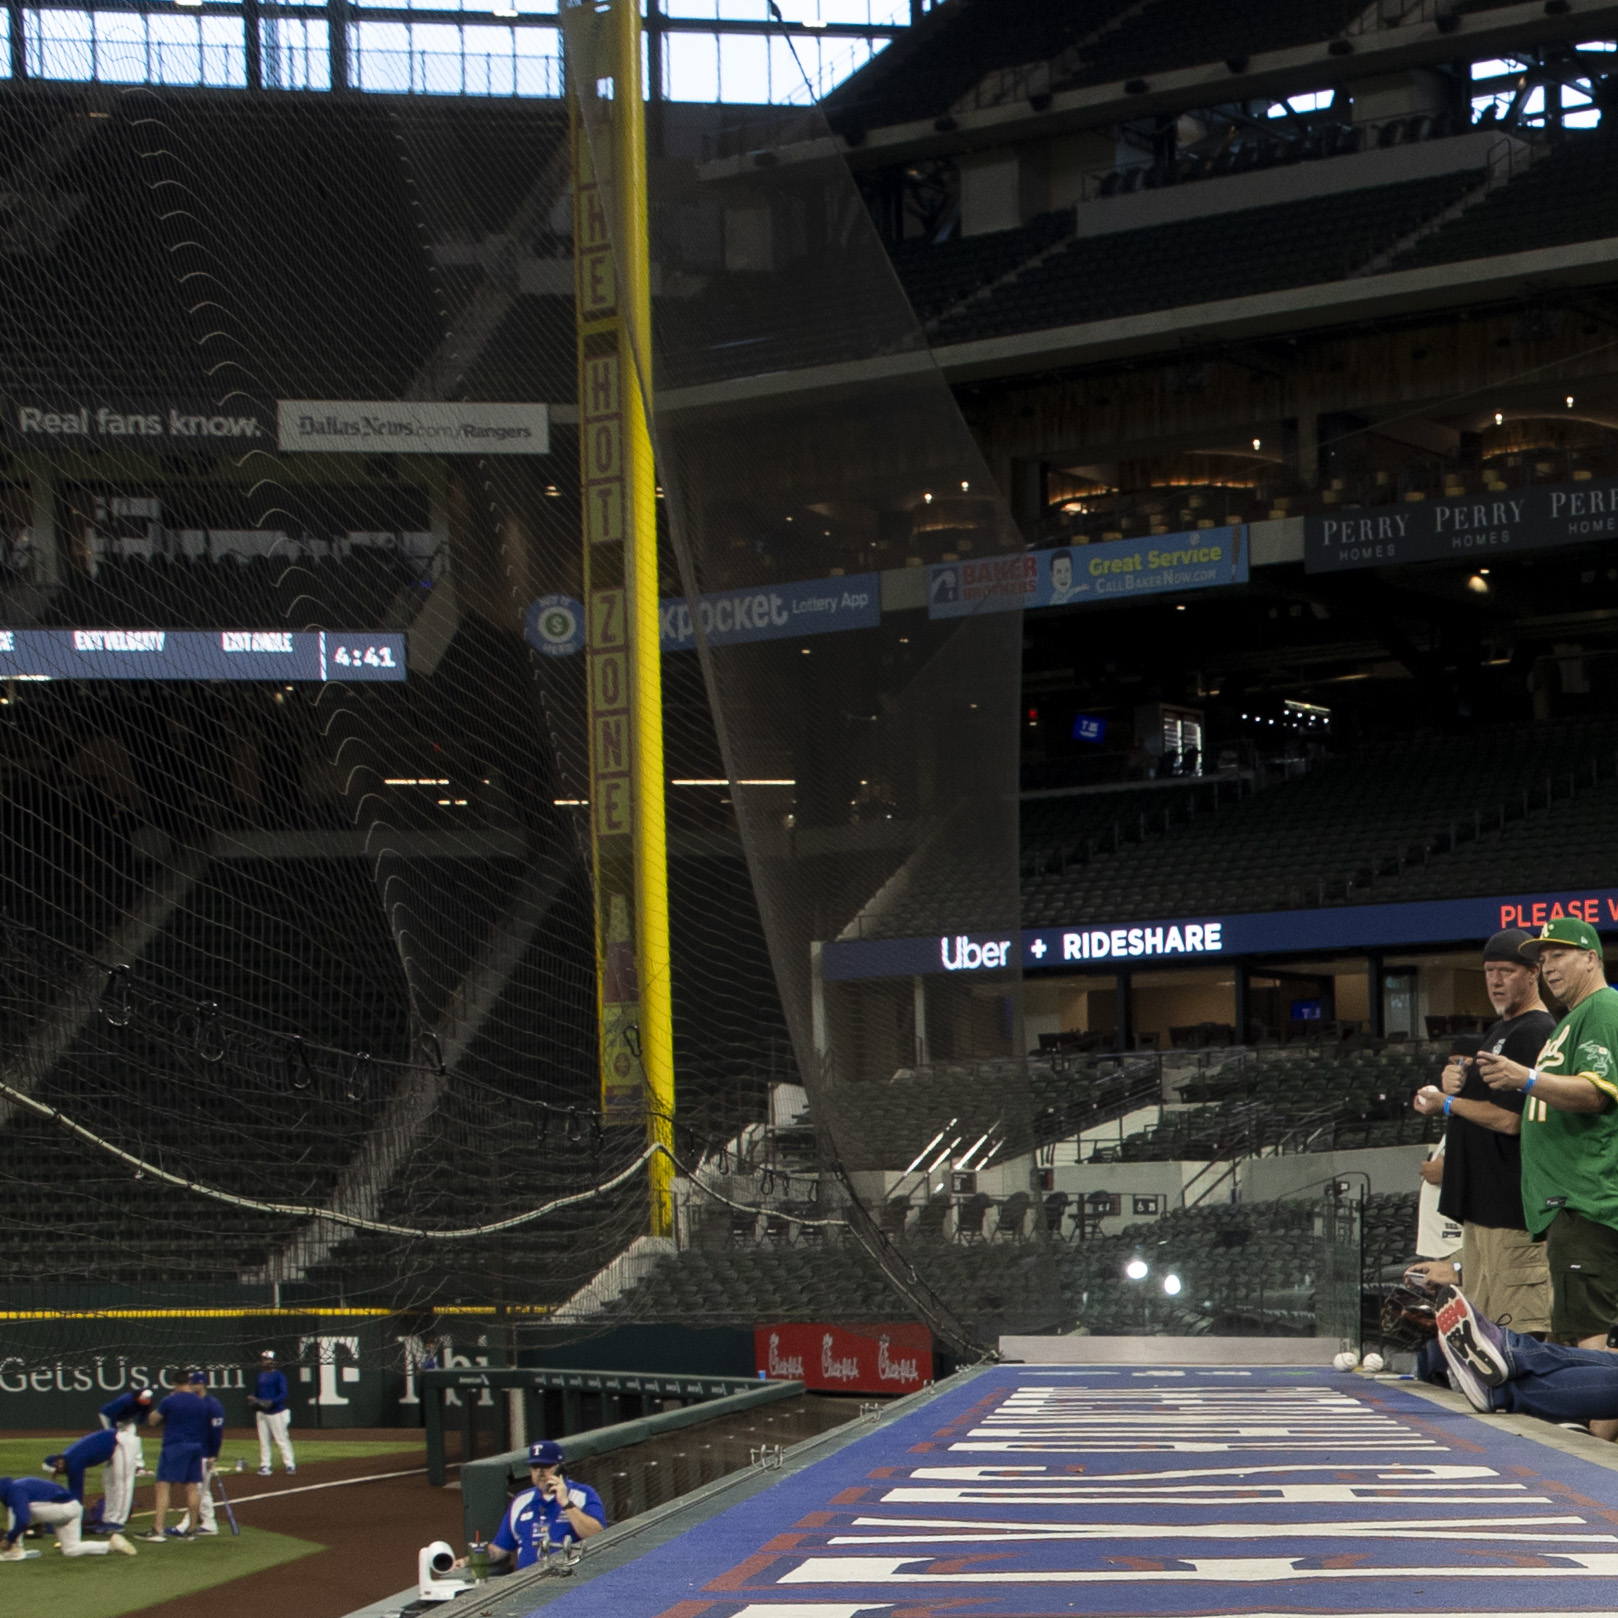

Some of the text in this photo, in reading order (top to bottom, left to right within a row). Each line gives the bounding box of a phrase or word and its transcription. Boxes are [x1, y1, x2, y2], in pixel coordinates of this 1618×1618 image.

[19, 407, 262, 438] Real fans know.
[591, 362, 617, 536] HOT
[1323, 513, 1410, 546] PERRY
[1434, 499, 1526, 534] PERRY
[1340, 544, 1396, 562] HOMES
[1451, 531, 1510, 549] HOMES
[963, 556, 1037, 585] BAKER
[1089, 545, 1222, 577] Great Service
[659, 592, 869, 642] kpocket Lottery App
[334, 647, 396, 669] 4:41
[592, 603, 622, 830] ZONE
[1500, 899, 1599, 929] PLEASE
[941, 936, 1011, 970] Uber
[1063, 923, 1222, 960] RIDESHARE
[0, 1356, 246, 1392] GetsUs.cm
